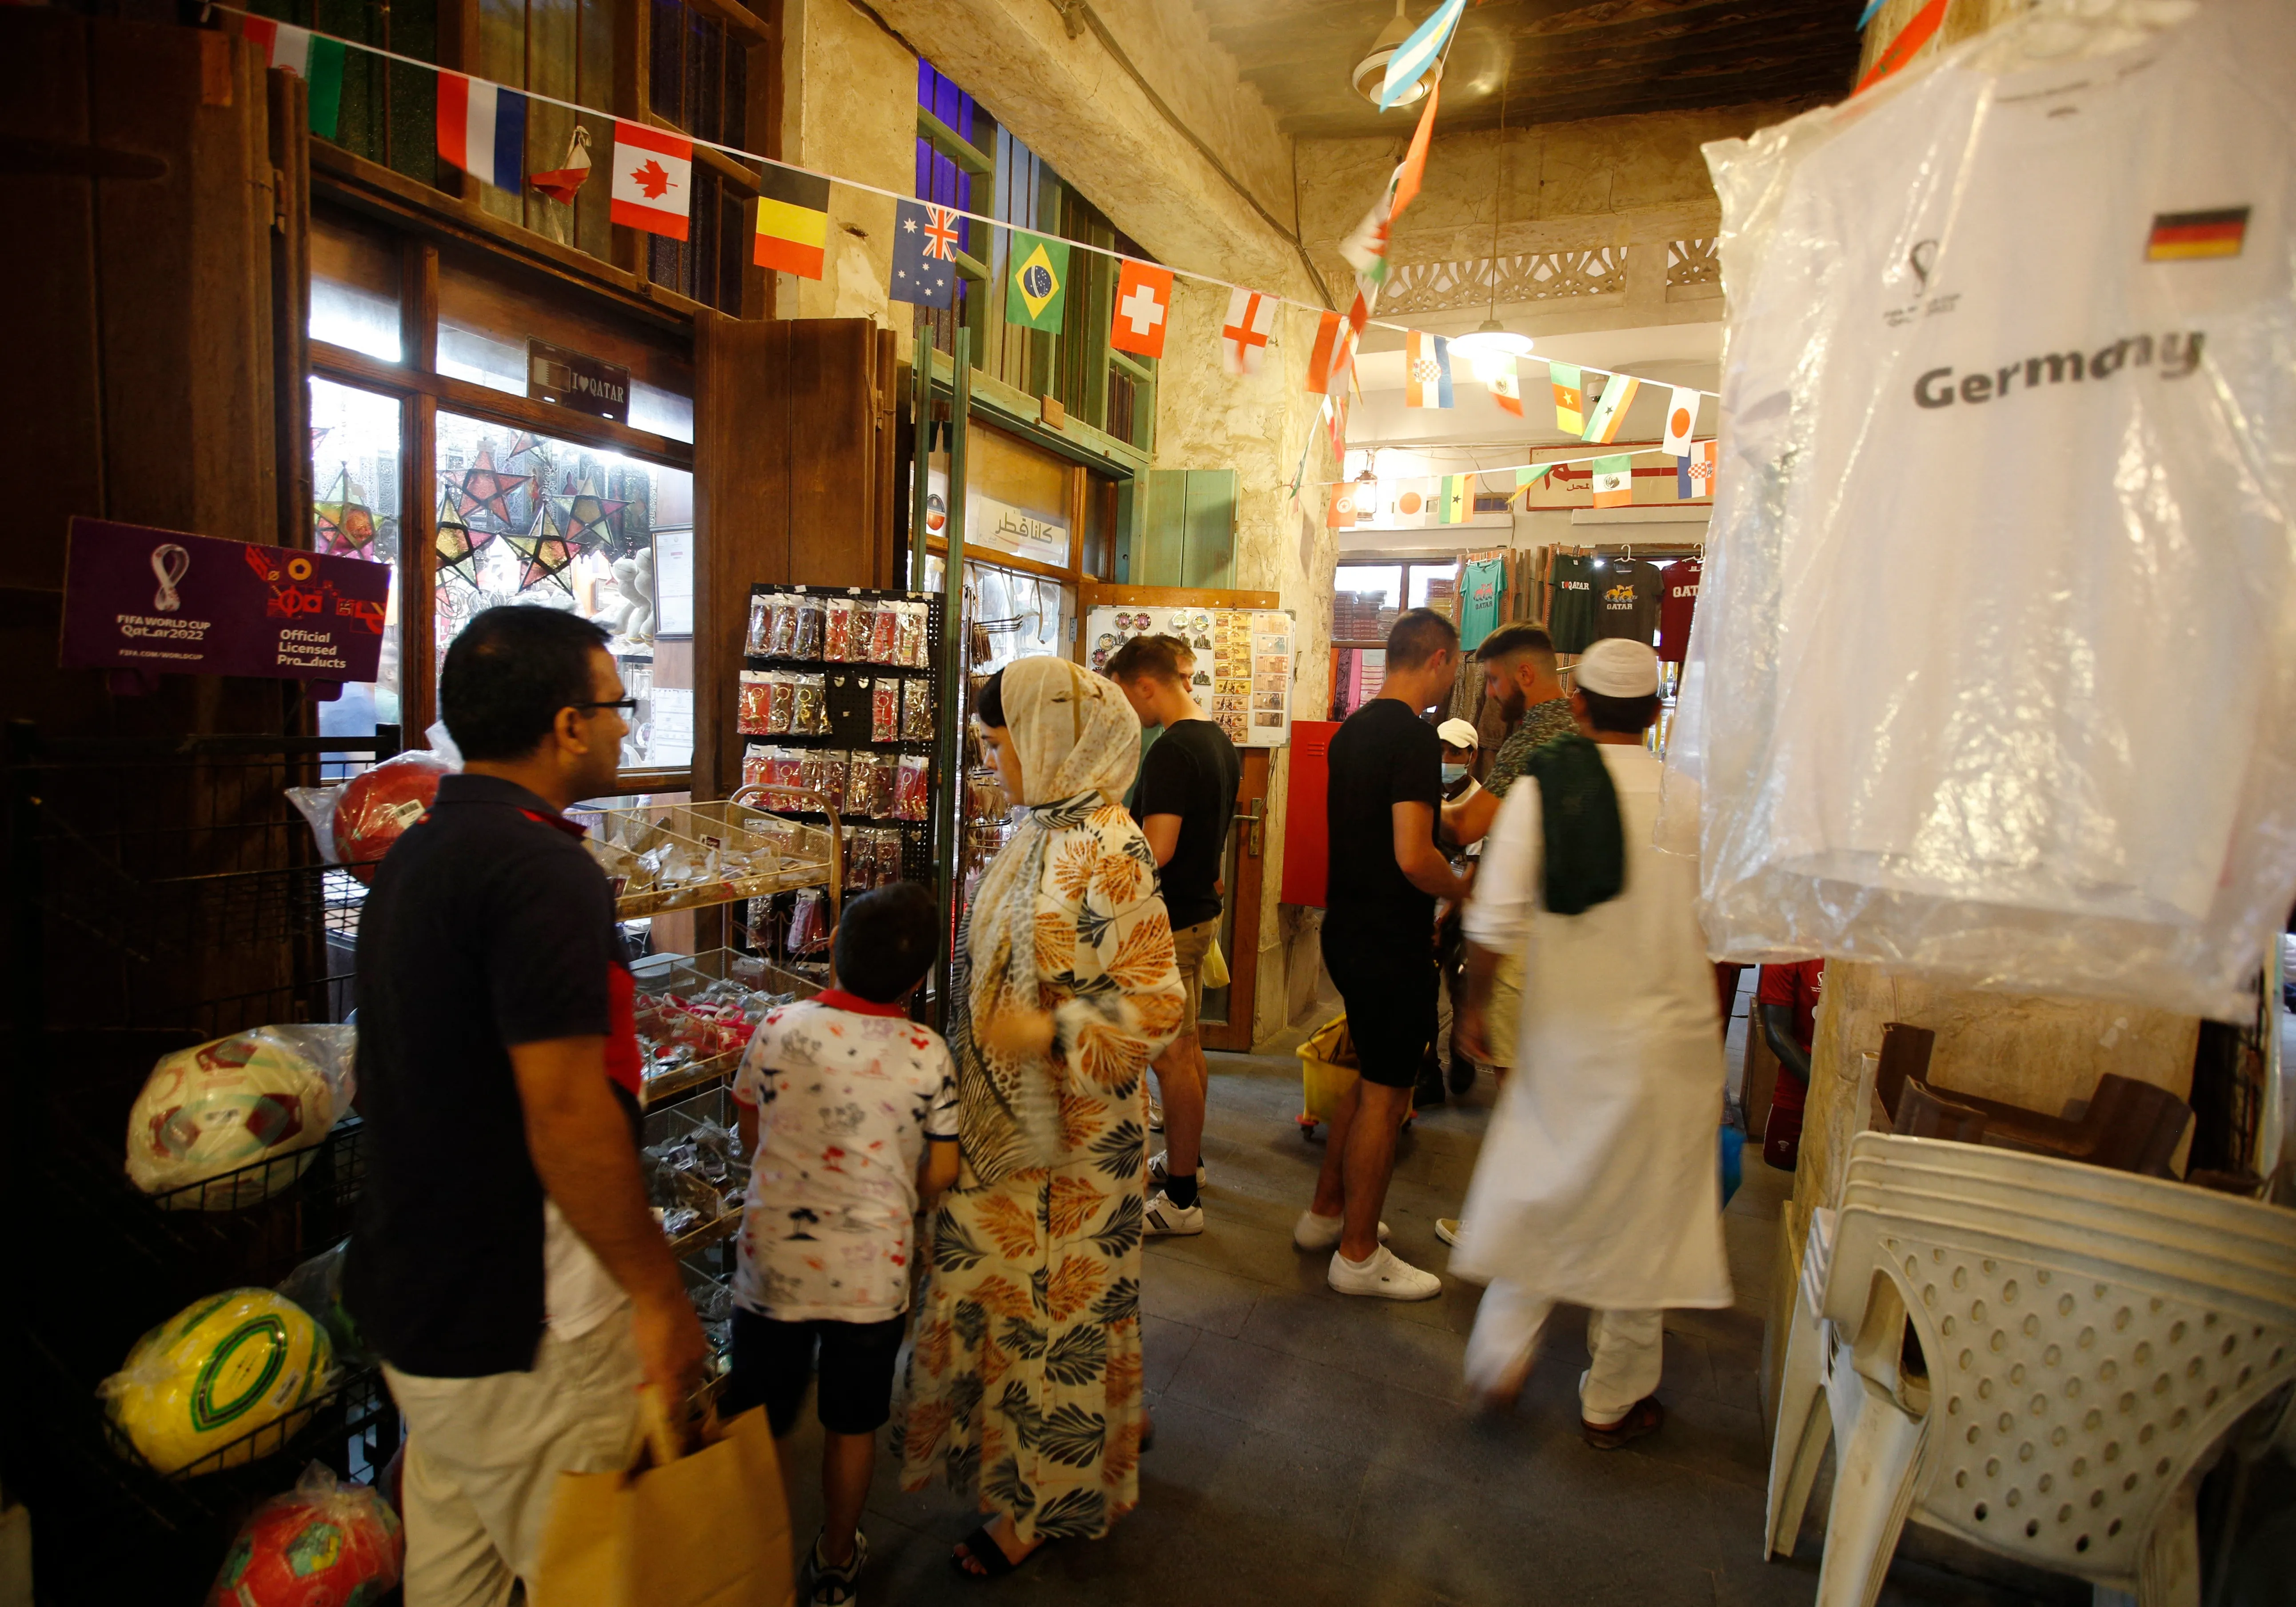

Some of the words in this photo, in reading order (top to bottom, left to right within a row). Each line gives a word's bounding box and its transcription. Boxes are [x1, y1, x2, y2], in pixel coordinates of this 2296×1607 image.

[1913, 331, 2206, 409] Germany
[572, 372, 578, 390] I
[590, 379, 624, 403] QATAR
[995, 512, 1029, 538] قطر
[1568, 581, 1590, 590] QATAR
[1673, 585, 1699, 598] QAT
[1475, 601, 1493, 610] QATAR
[117, 615, 143, 625] FIFA
[145, 617, 187, 628] WORLD
[188, 621, 211, 630] CUP
[280, 629, 331, 643] Official
[279, 642, 338, 655] Licensed
[277, 654, 347, 668] Products
